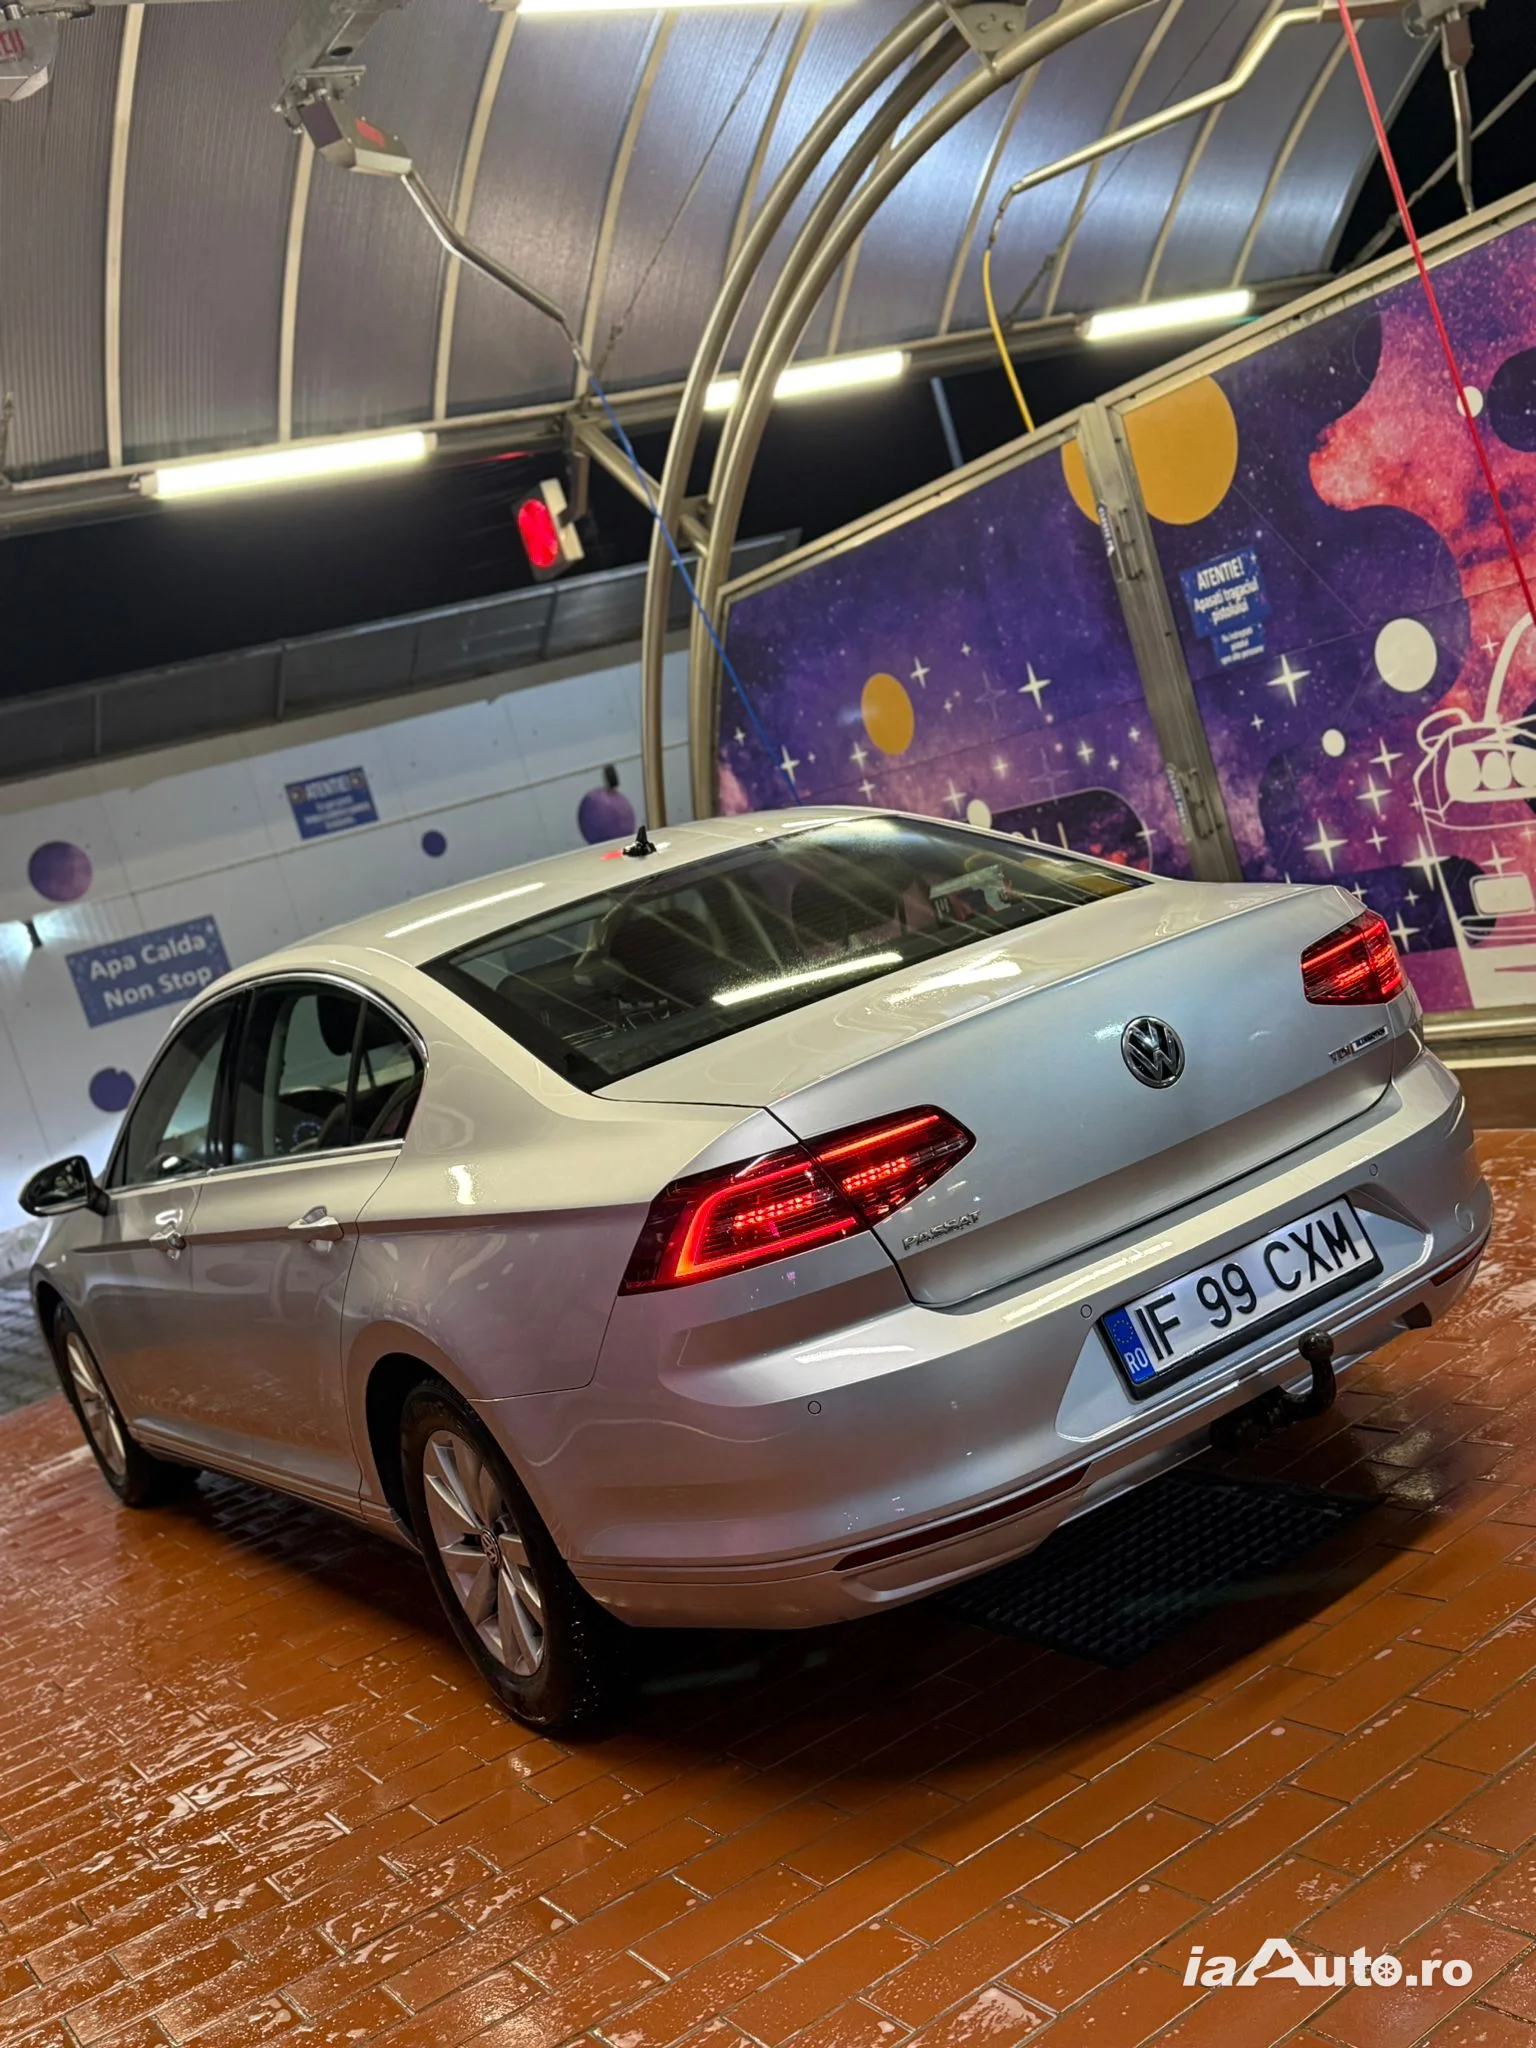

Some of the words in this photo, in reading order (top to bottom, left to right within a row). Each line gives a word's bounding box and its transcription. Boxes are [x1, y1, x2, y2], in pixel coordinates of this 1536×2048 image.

[1197, 556, 1245, 591] ATENTIE!
[90, 953, 137, 981] Apa
[140, 933, 206, 964] Calda
[103, 982, 155, 1010] Non
[157, 965, 212, 994] Stop
[902, 1209, 980, 1251] PASSAT
[1136, 1292, 1181, 1361] IF
[1196, 1262, 1257, 1328] 99
[1263, 1211, 1360, 1291] CXM
[1124, 1347, 1149, 1374] RO
